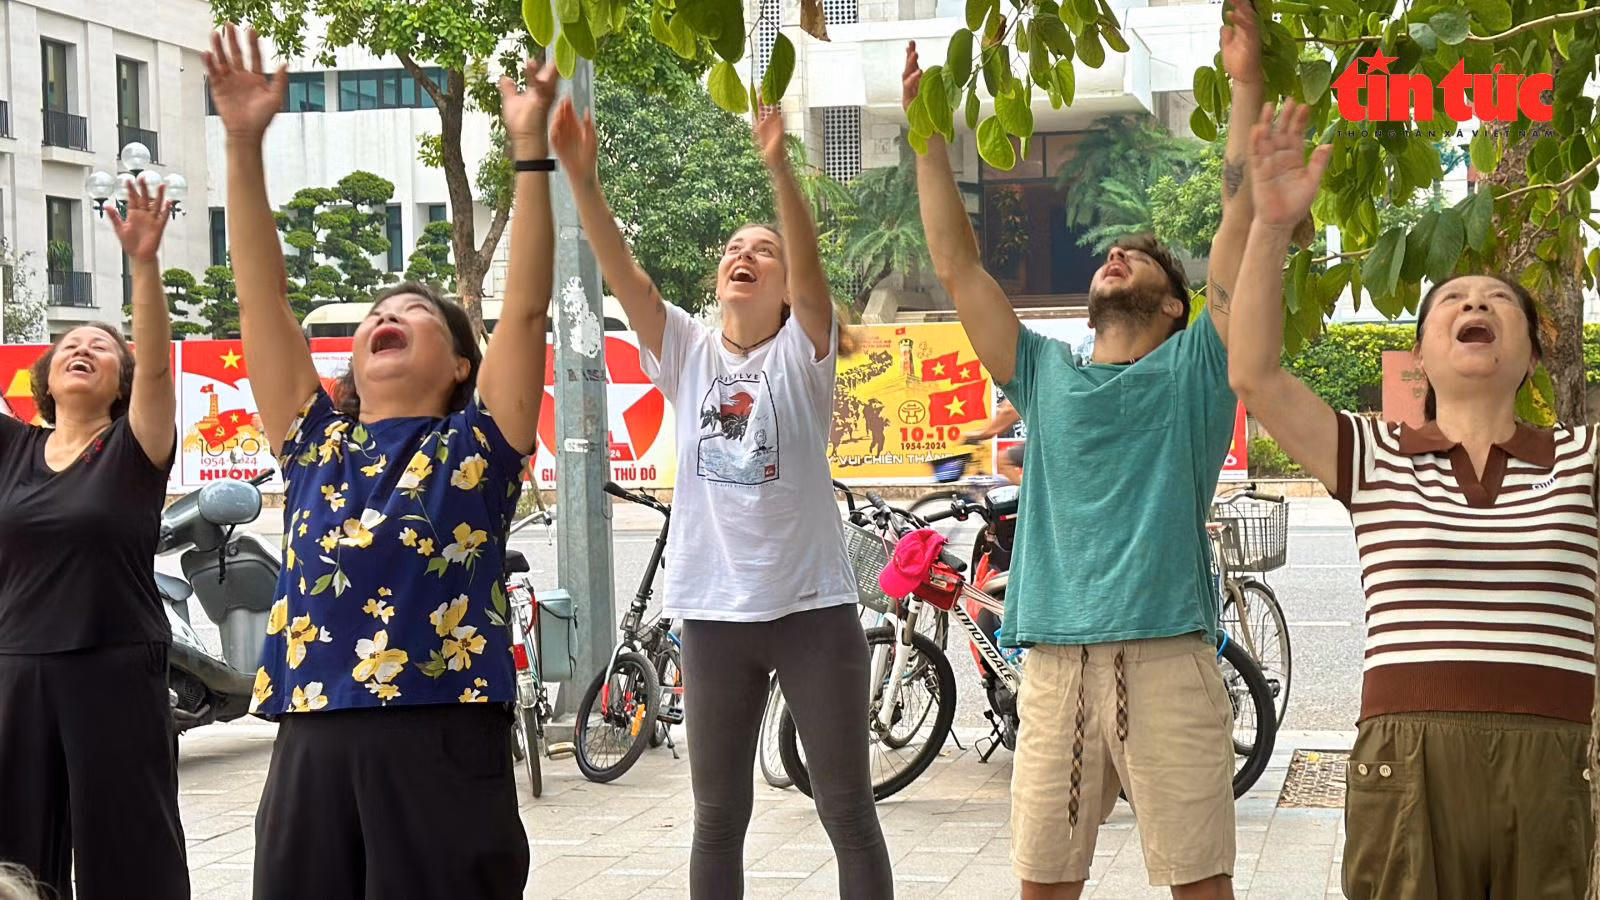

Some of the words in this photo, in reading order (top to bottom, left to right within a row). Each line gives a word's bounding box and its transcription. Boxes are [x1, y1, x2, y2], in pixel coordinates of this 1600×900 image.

[900, 426, 960, 442] 10-10
[900, 441, 947, 450] 1954-2024
[201, 457, 257, 467] 1954-024
[839, 455, 861, 465] VUI
[614, 463, 637, 481] THỦ
[639, 464, 657, 481] ĐÔ
